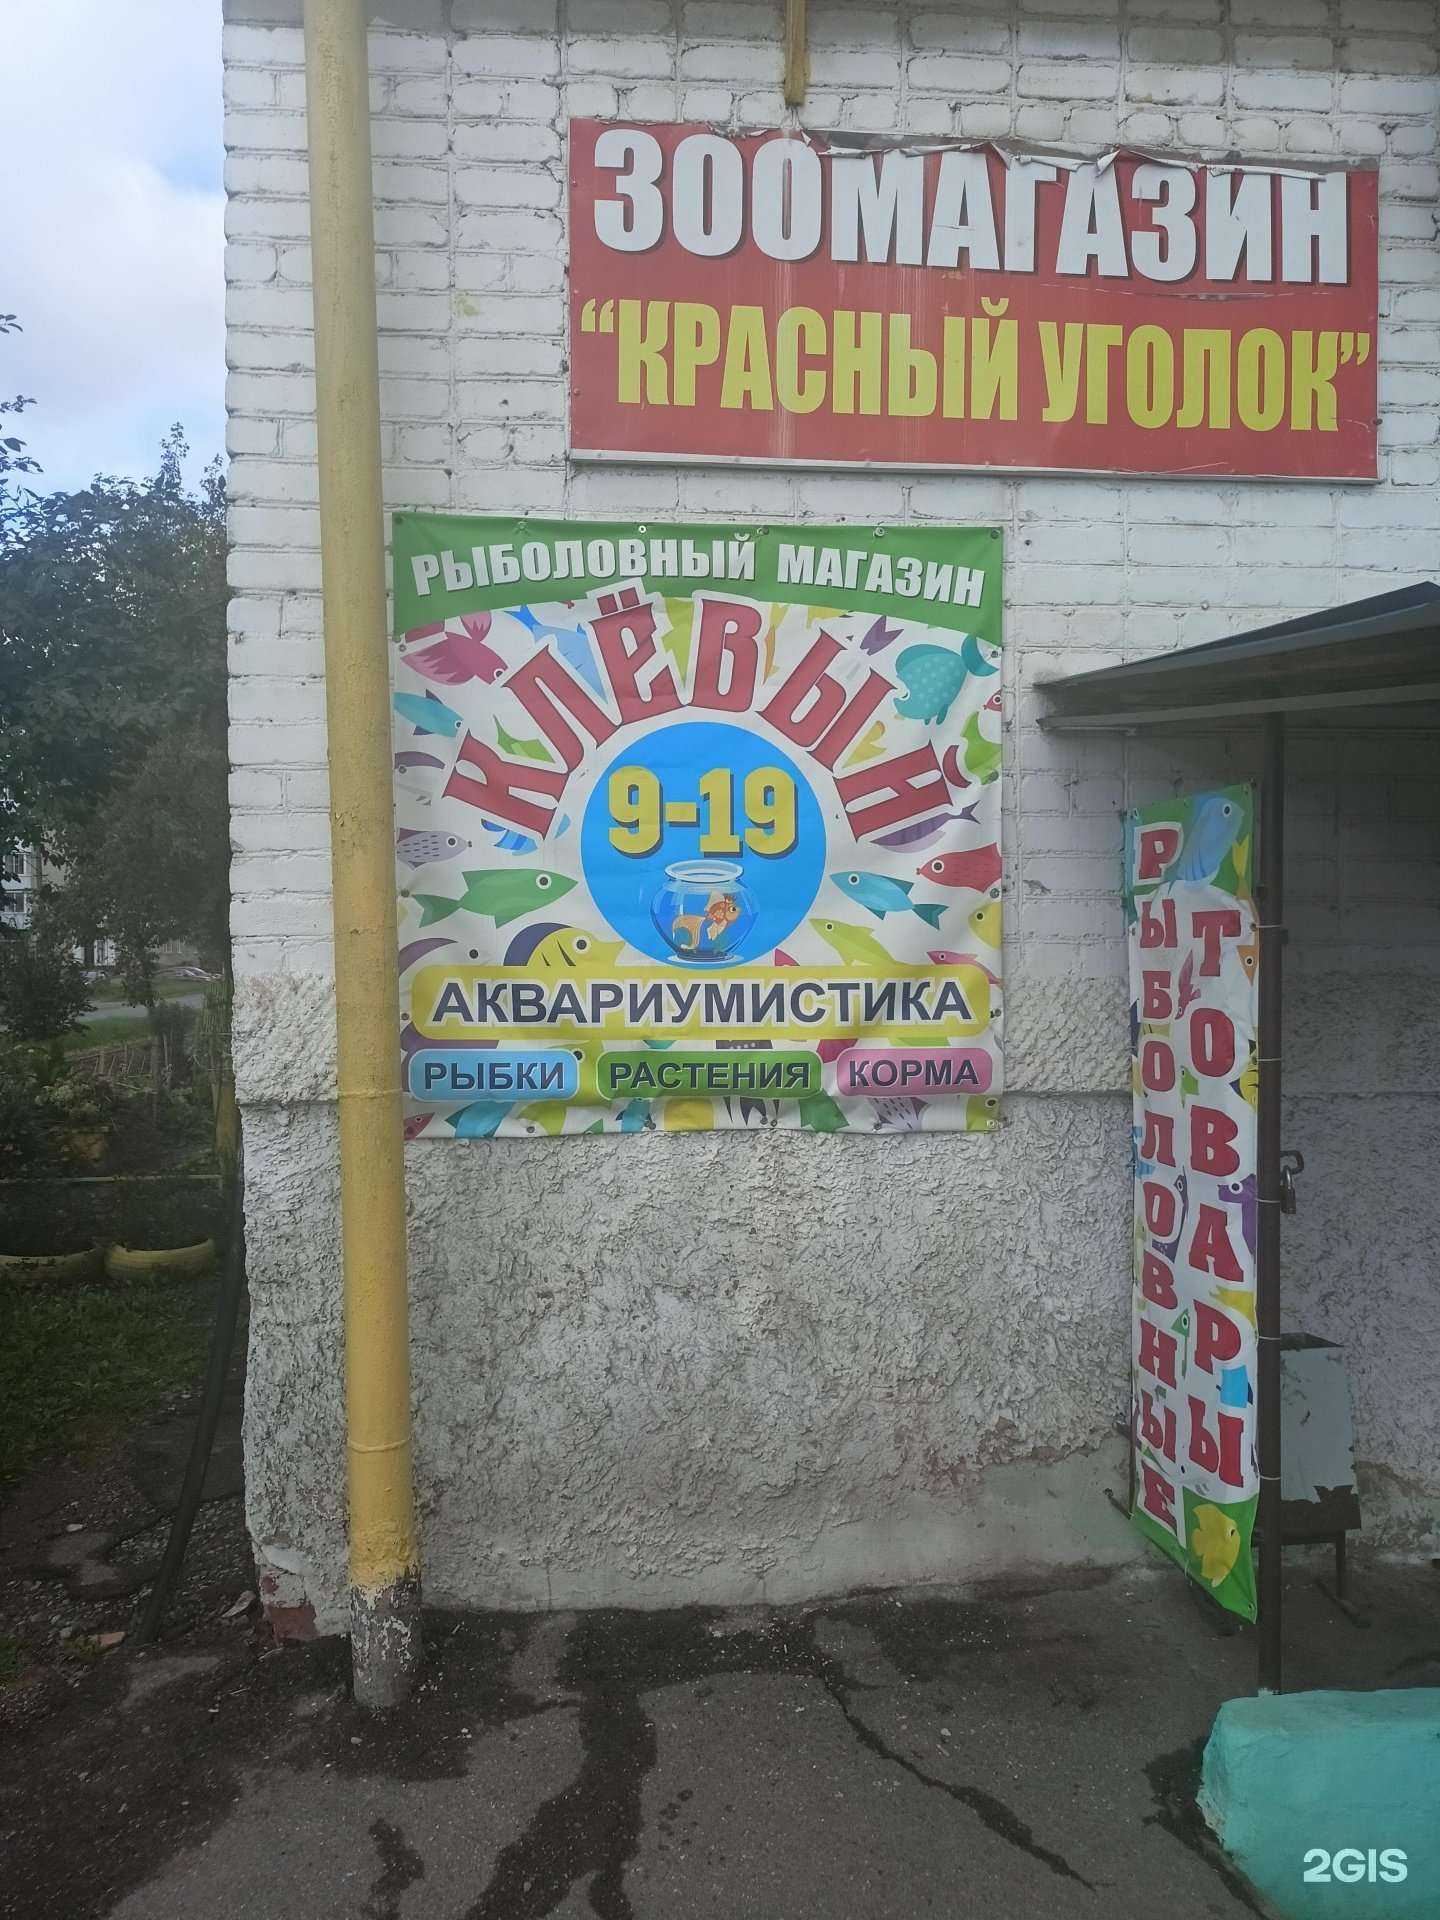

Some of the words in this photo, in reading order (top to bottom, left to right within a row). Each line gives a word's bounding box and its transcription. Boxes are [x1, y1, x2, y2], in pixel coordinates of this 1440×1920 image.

[594, 129, 1349, 284] ЗООМАГАЗИН
[411, 533, 755, 596] РЫБОЛОВНЫЙ
[777, 543, 985, 608] МАГАЗИН
[607, 765, 799, 858] 9-19
[432, 981, 972, 1024] АКВАРИУМИСТИКА
[424, 1062, 565, 1091] РЫБКИ
[608, 1062, 811, 1090] РАСТЕНИЯ
[848, 1058, 980, 1087] КОРМА
[1138, 828, 1182, 1538] РЫБОЛОВНЫЕ
[1188, 909, 1243, 1488] ТОВАРЫ
